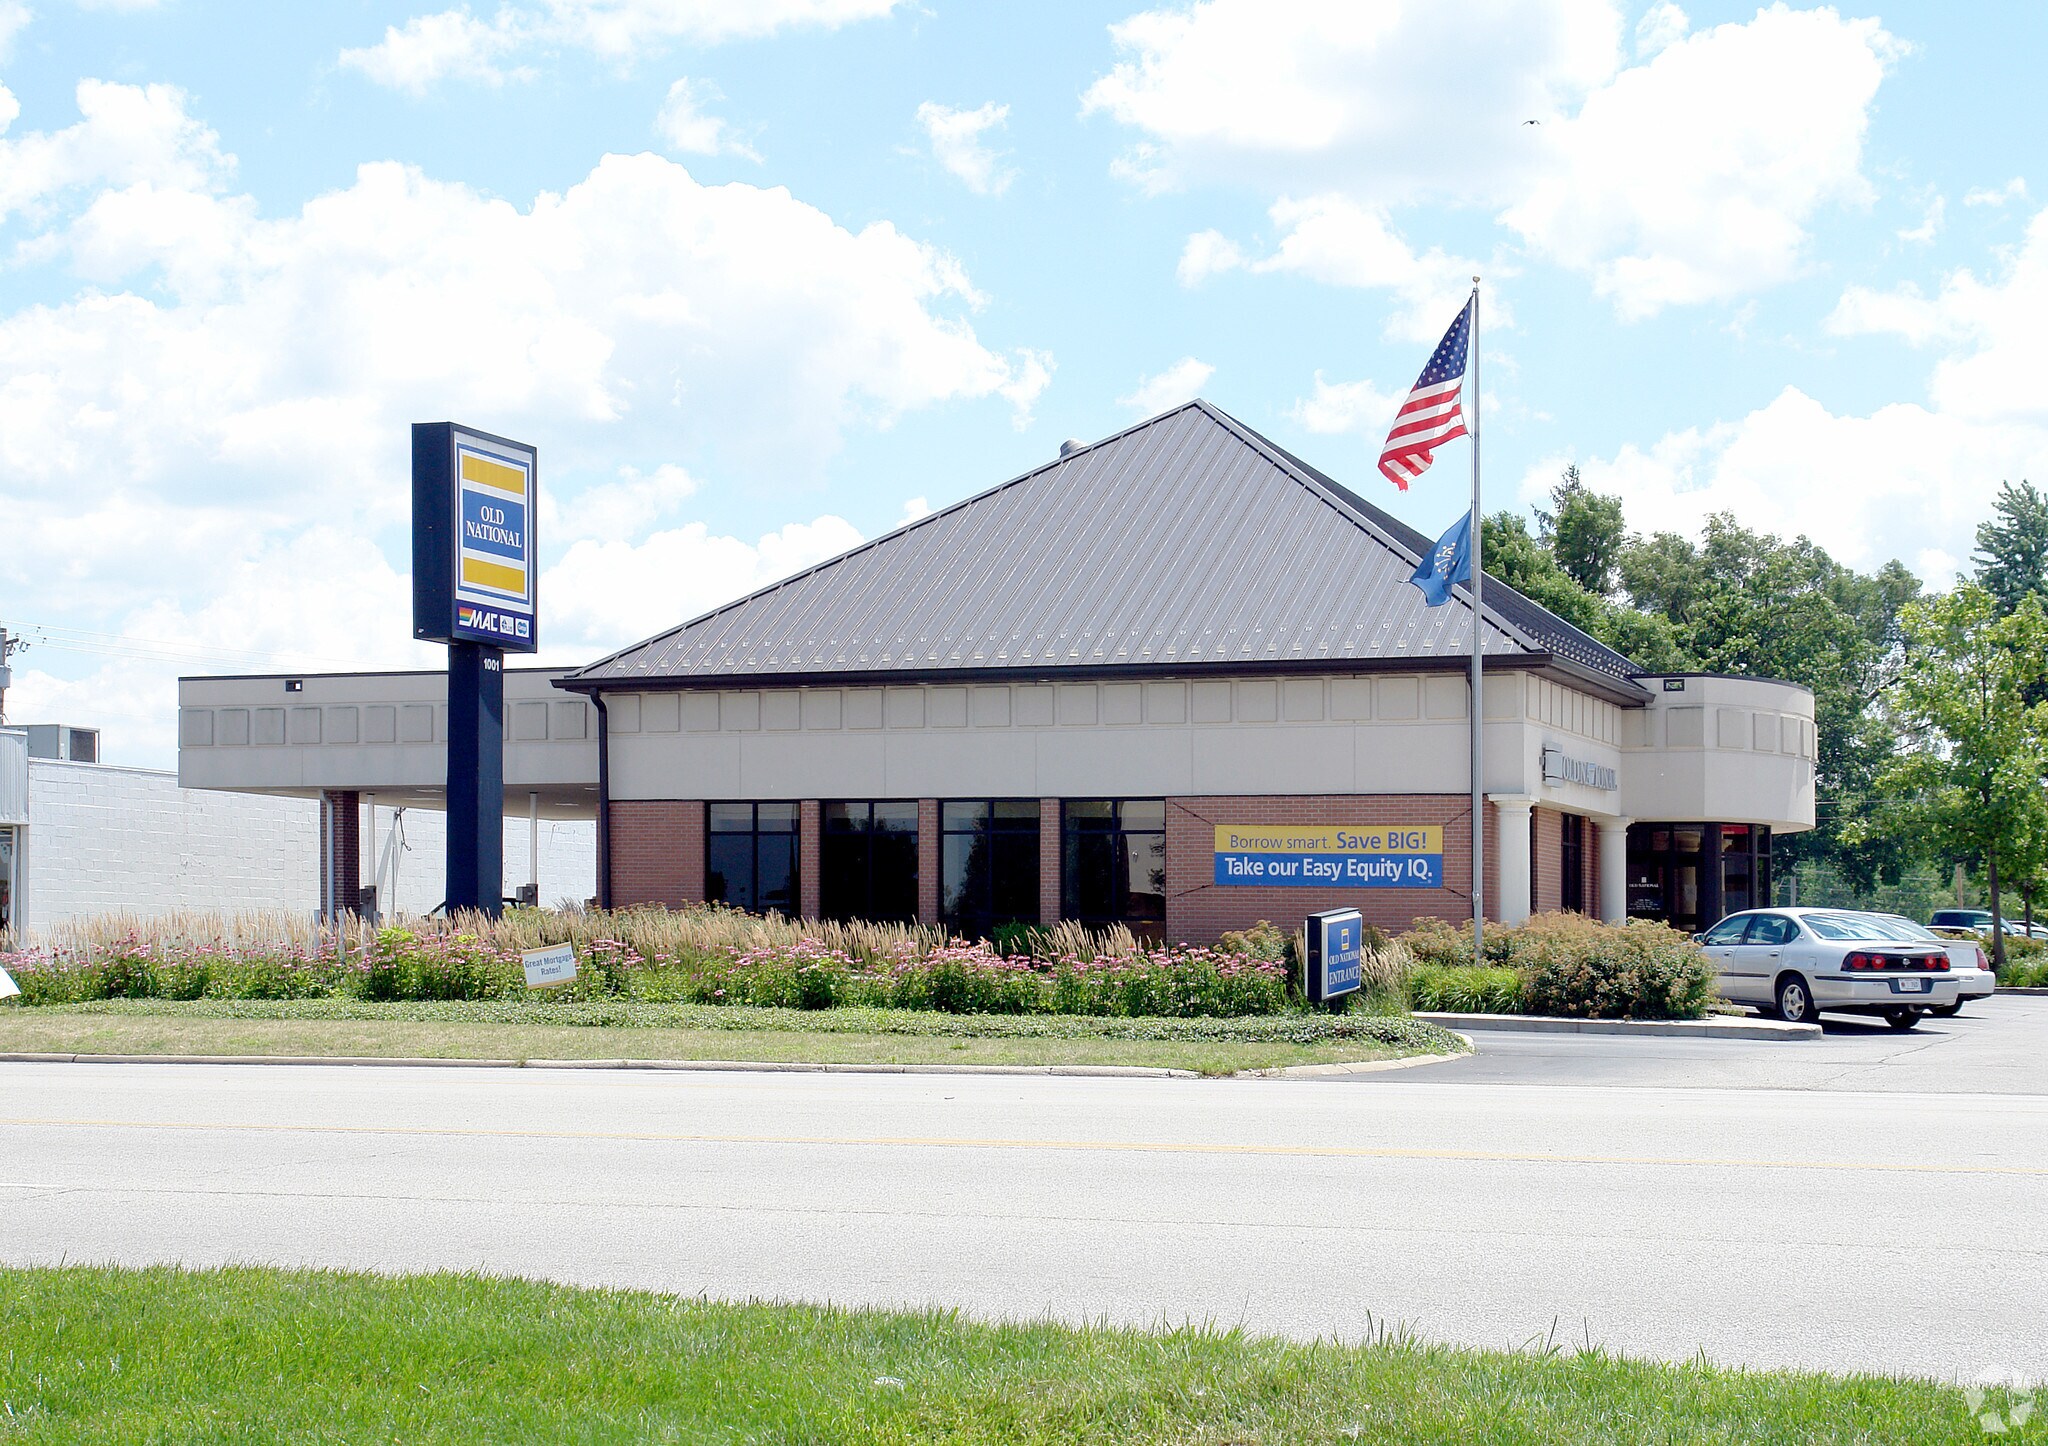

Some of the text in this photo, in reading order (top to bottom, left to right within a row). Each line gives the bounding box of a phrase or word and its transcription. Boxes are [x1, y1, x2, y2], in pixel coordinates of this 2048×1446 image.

[480, 505, 505, 525] OLD
[466, 520, 522, 548] NATIONAL
[469, 609, 498, 632] MAC
[484, 658, 499, 672] 1001
[1230, 831, 1427, 850] Borrow smart. Save BIG!
[1224, 856, 1433, 882] Take our Easy Equity IQ.
[524, 953, 572, 968] Great Mortgage
[1329, 954, 1339, 965] OLD
[540, 965, 561, 976] Rates!
[1329, 965, 1359, 985] ENTRANCE
